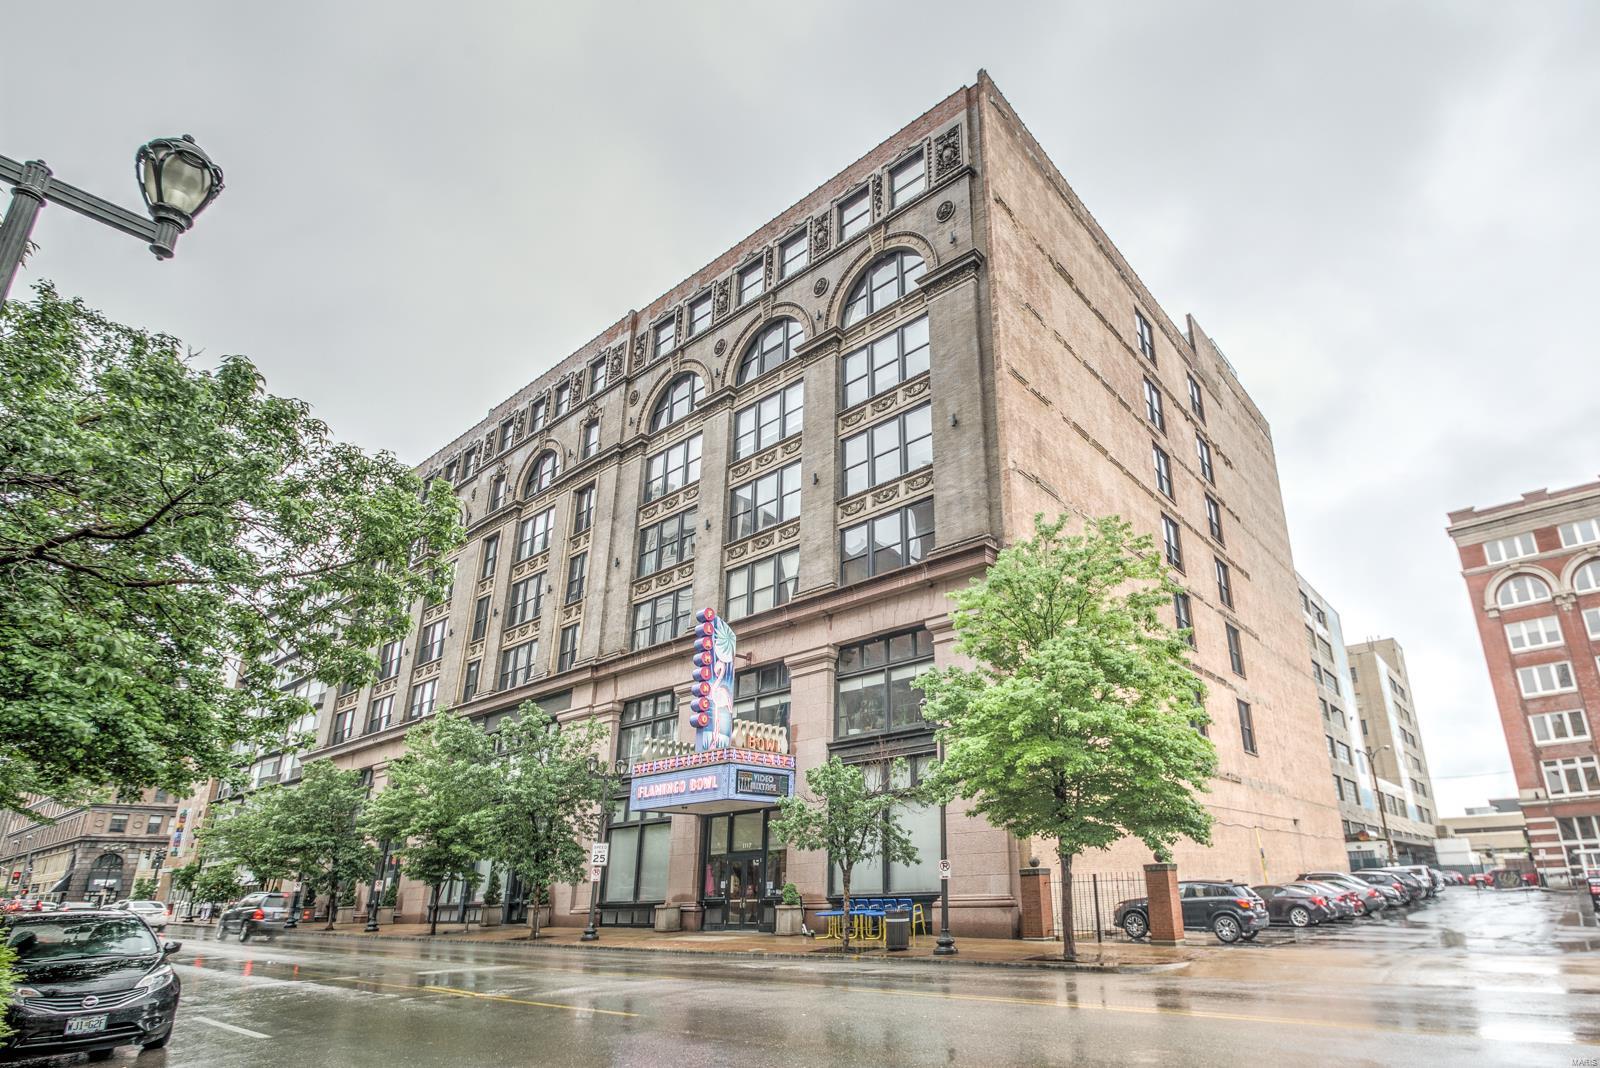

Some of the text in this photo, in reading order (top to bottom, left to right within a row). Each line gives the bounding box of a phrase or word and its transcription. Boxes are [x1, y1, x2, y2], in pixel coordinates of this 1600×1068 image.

[701, 609, 713, 724] FLAMINGO
[753, 773, 774, 783] VIDEO
[637, 780, 686, 799] FLAMINGO
[688, 775, 718, 792] BOWL
[593, 854, 606, 863] 25
